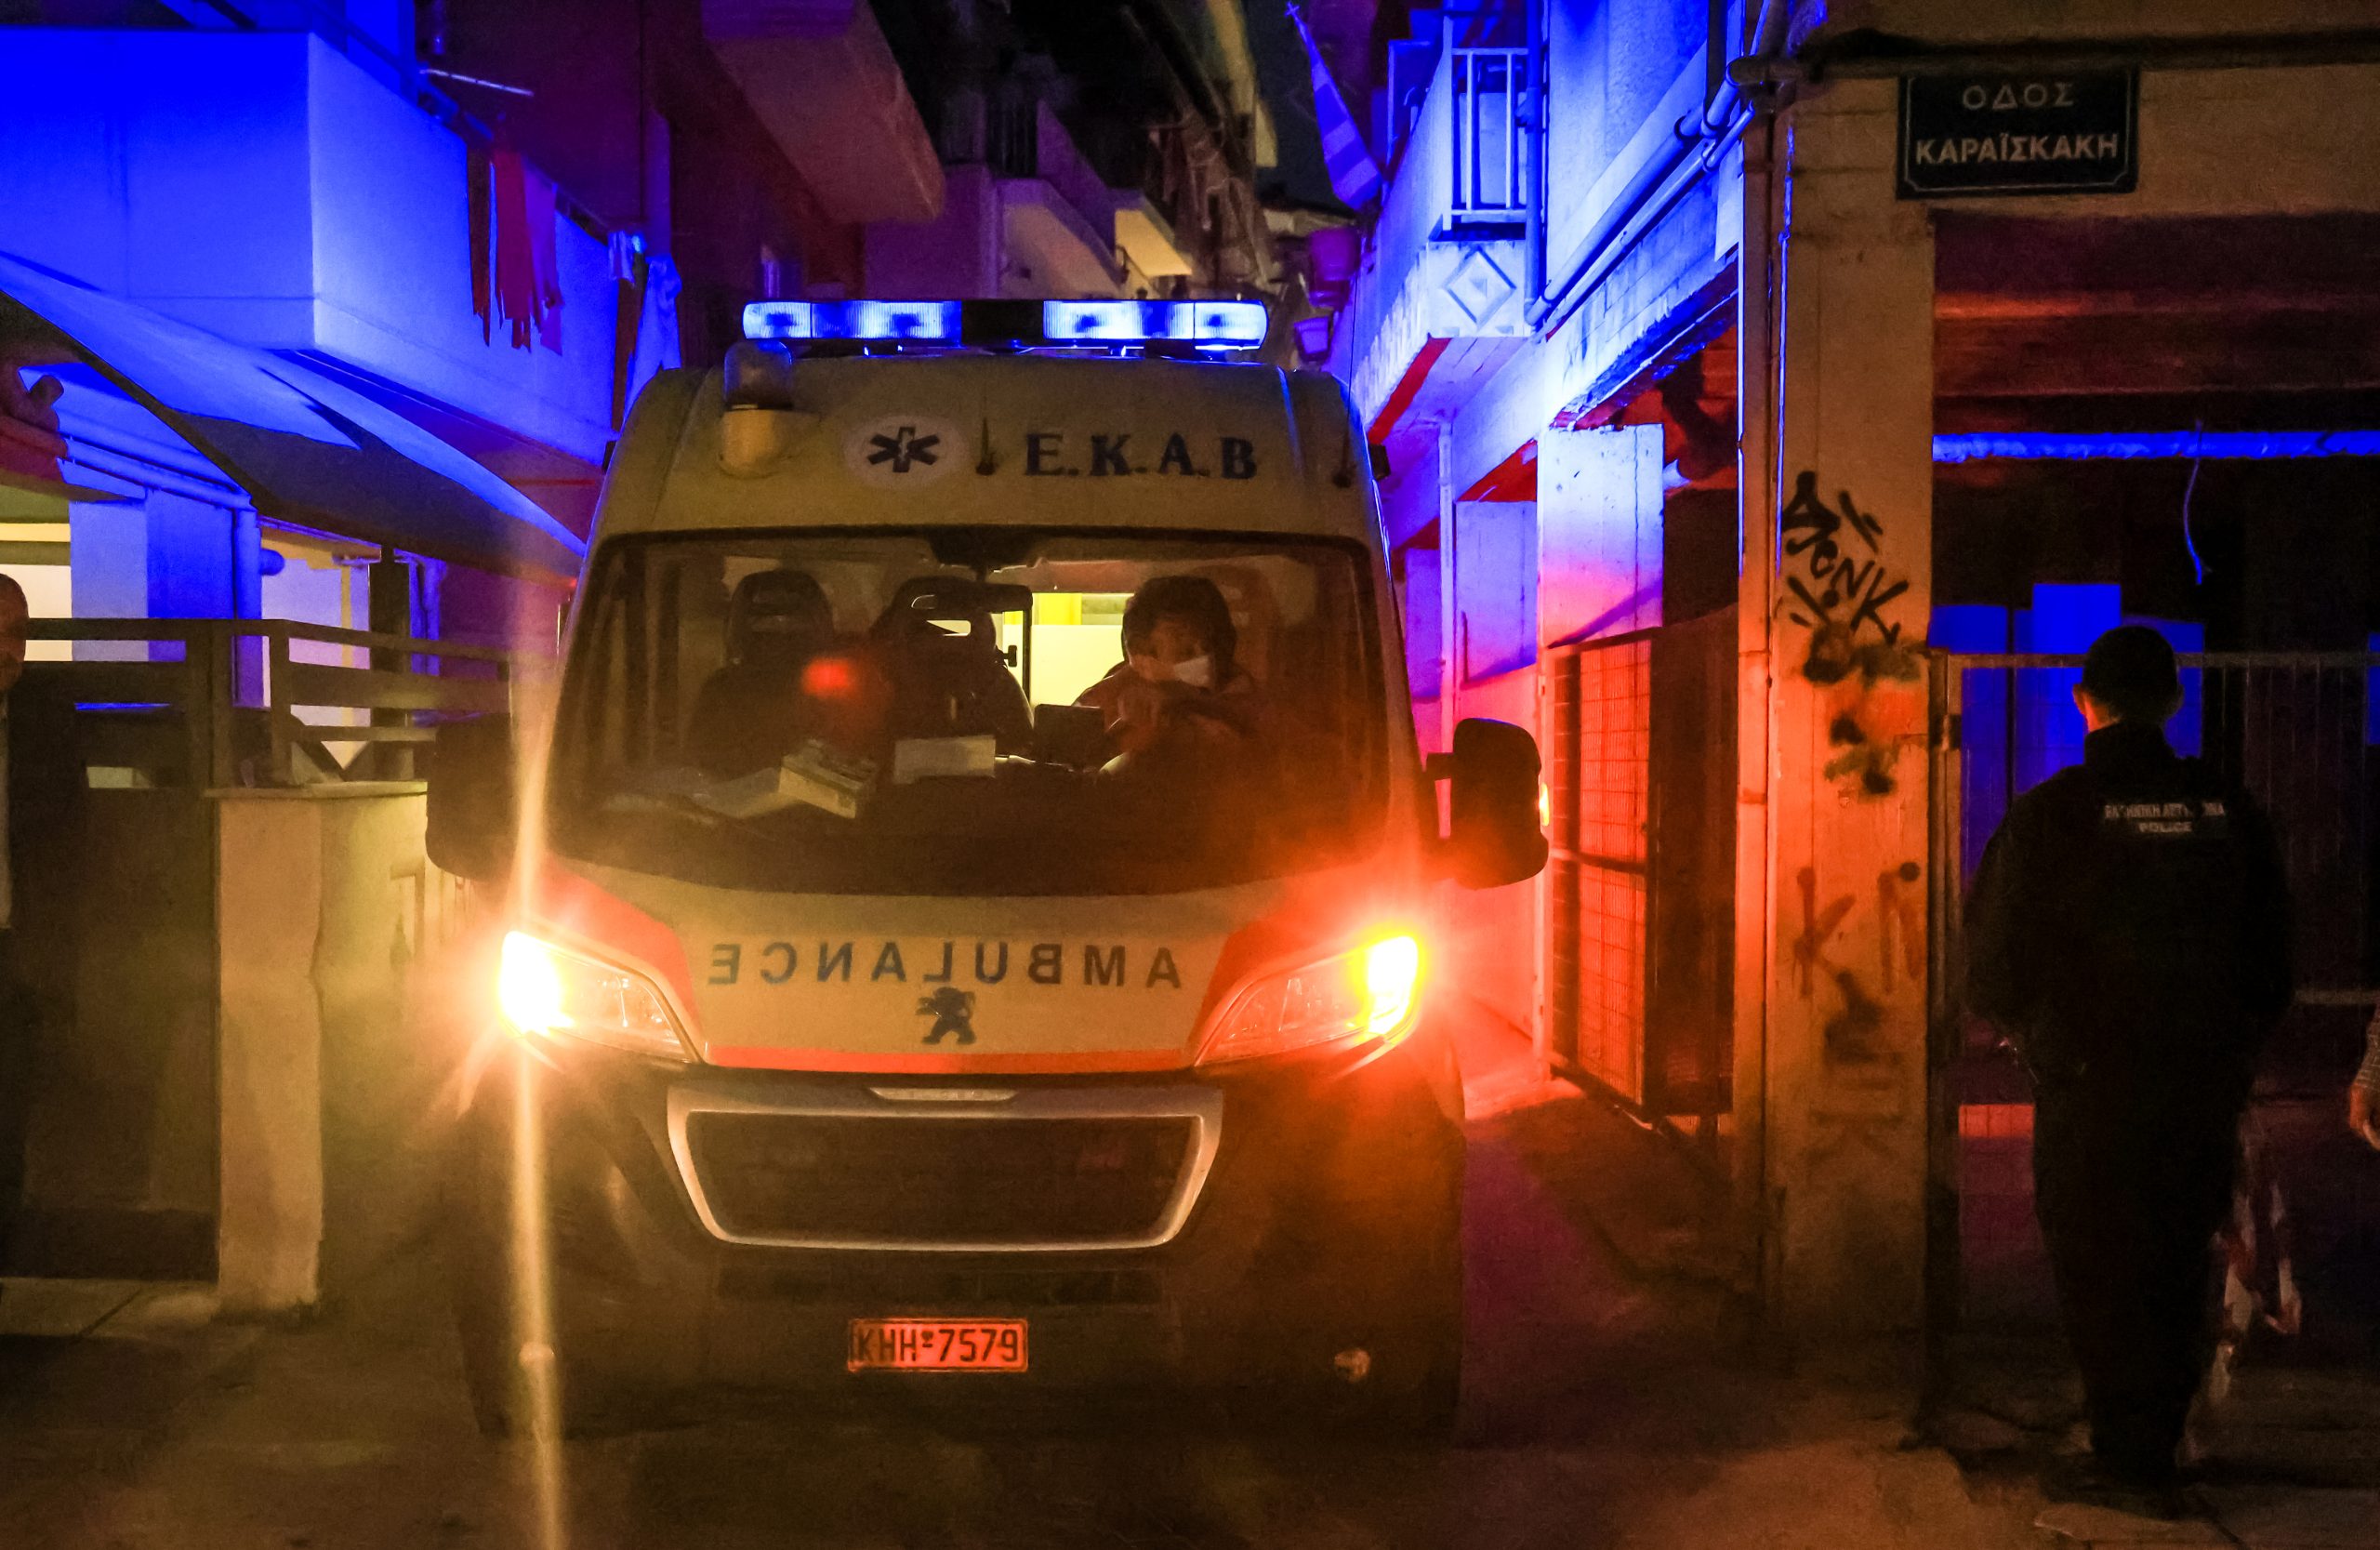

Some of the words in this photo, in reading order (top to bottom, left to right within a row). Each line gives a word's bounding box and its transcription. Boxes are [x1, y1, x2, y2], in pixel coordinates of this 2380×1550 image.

[1963, 83, 2074, 110] ΟΔΟΣ
[1916, 132, 2119, 165] ΚΑΡΑΪΣΚΑΚΗ
[2138, 822, 2192, 832] POLICE
